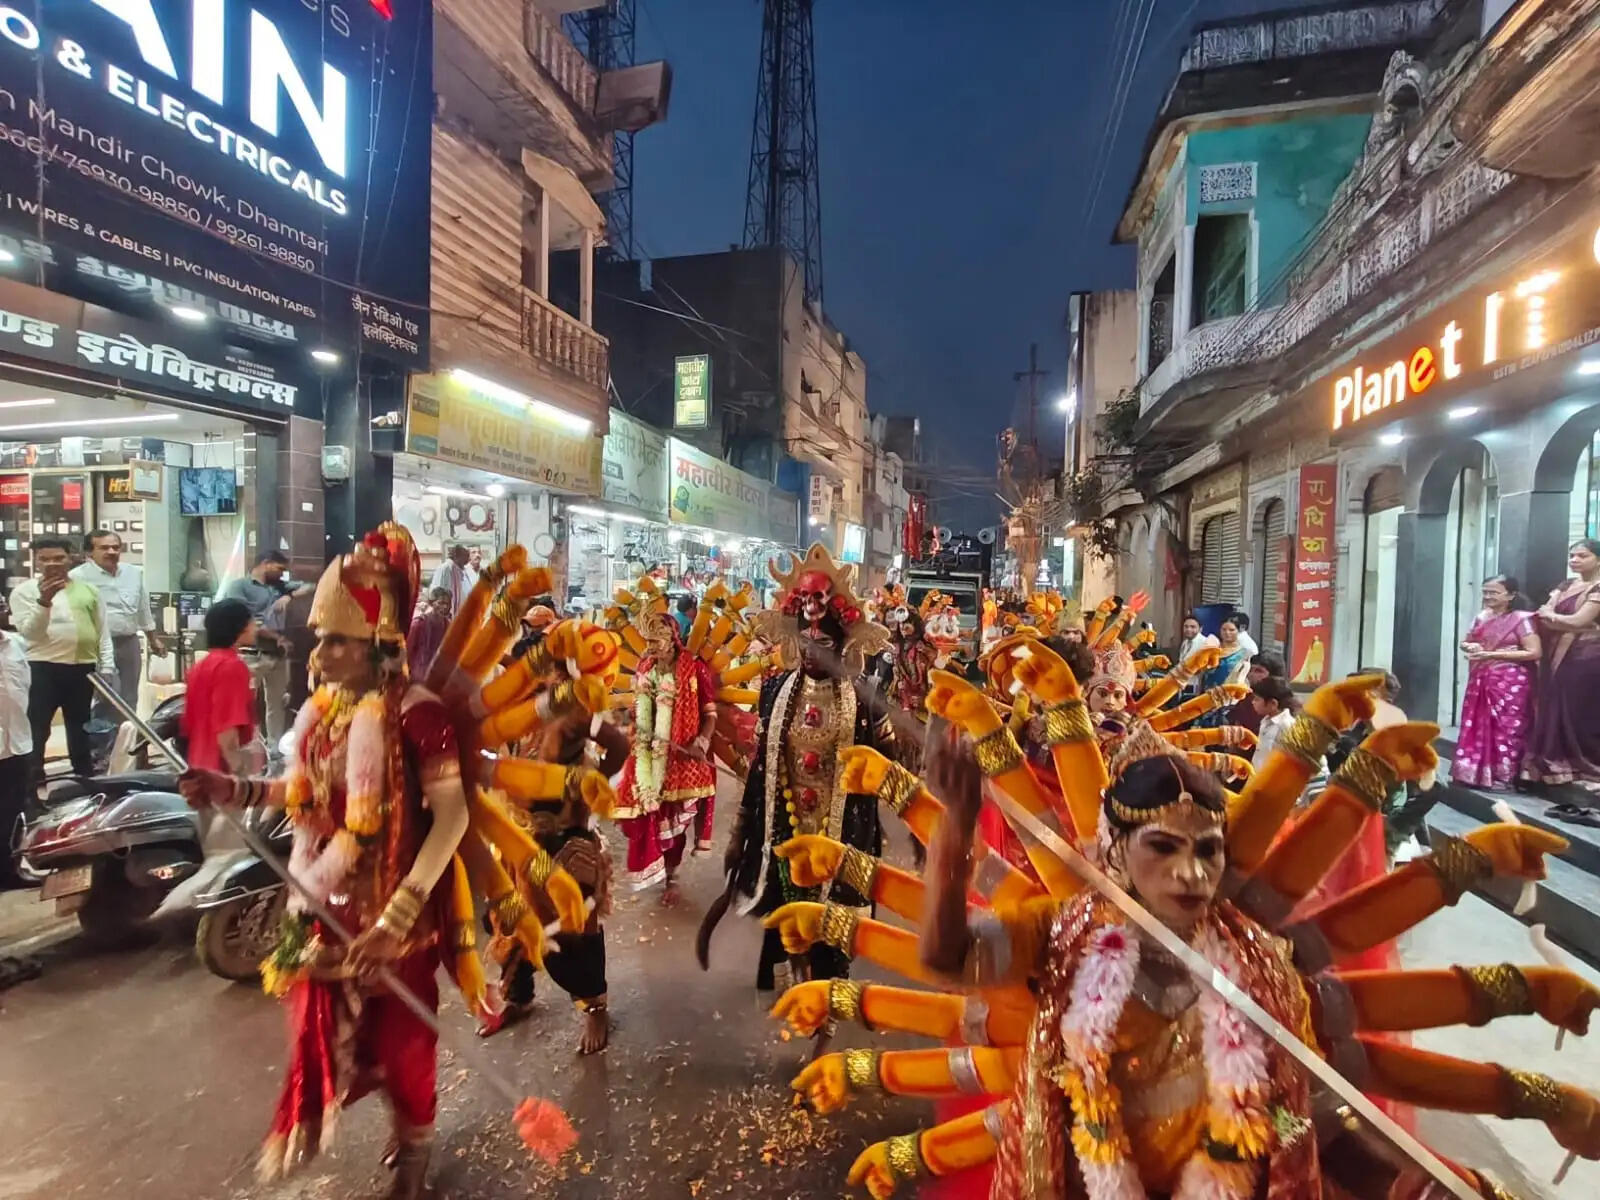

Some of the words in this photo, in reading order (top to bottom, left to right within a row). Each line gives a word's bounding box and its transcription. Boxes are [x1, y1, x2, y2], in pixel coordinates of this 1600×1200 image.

[57, 38, 93, 79] &
[107, 63, 349, 216] ELECTRICALS
[29, 98, 136, 164] Mandir
[141, 154, 231, 214] Chowk,
[238, 199, 330, 256] Dhamtari
[17, 196, 80, 231] WRES
[100, 229, 162, 261] CABLES
[173, 257, 203, 278] PVC
[204, 268, 281, 307] INSULATION
[281, 294, 317, 319] TAPES
[215, 215, 316, 273] 99261-98850
[351, 292, 371, 317] जैन
[676, 357, 705, 374] महावीर
[1333, 319, 1465, 431] Planet
[676, 456, 733, 496] महावीर
